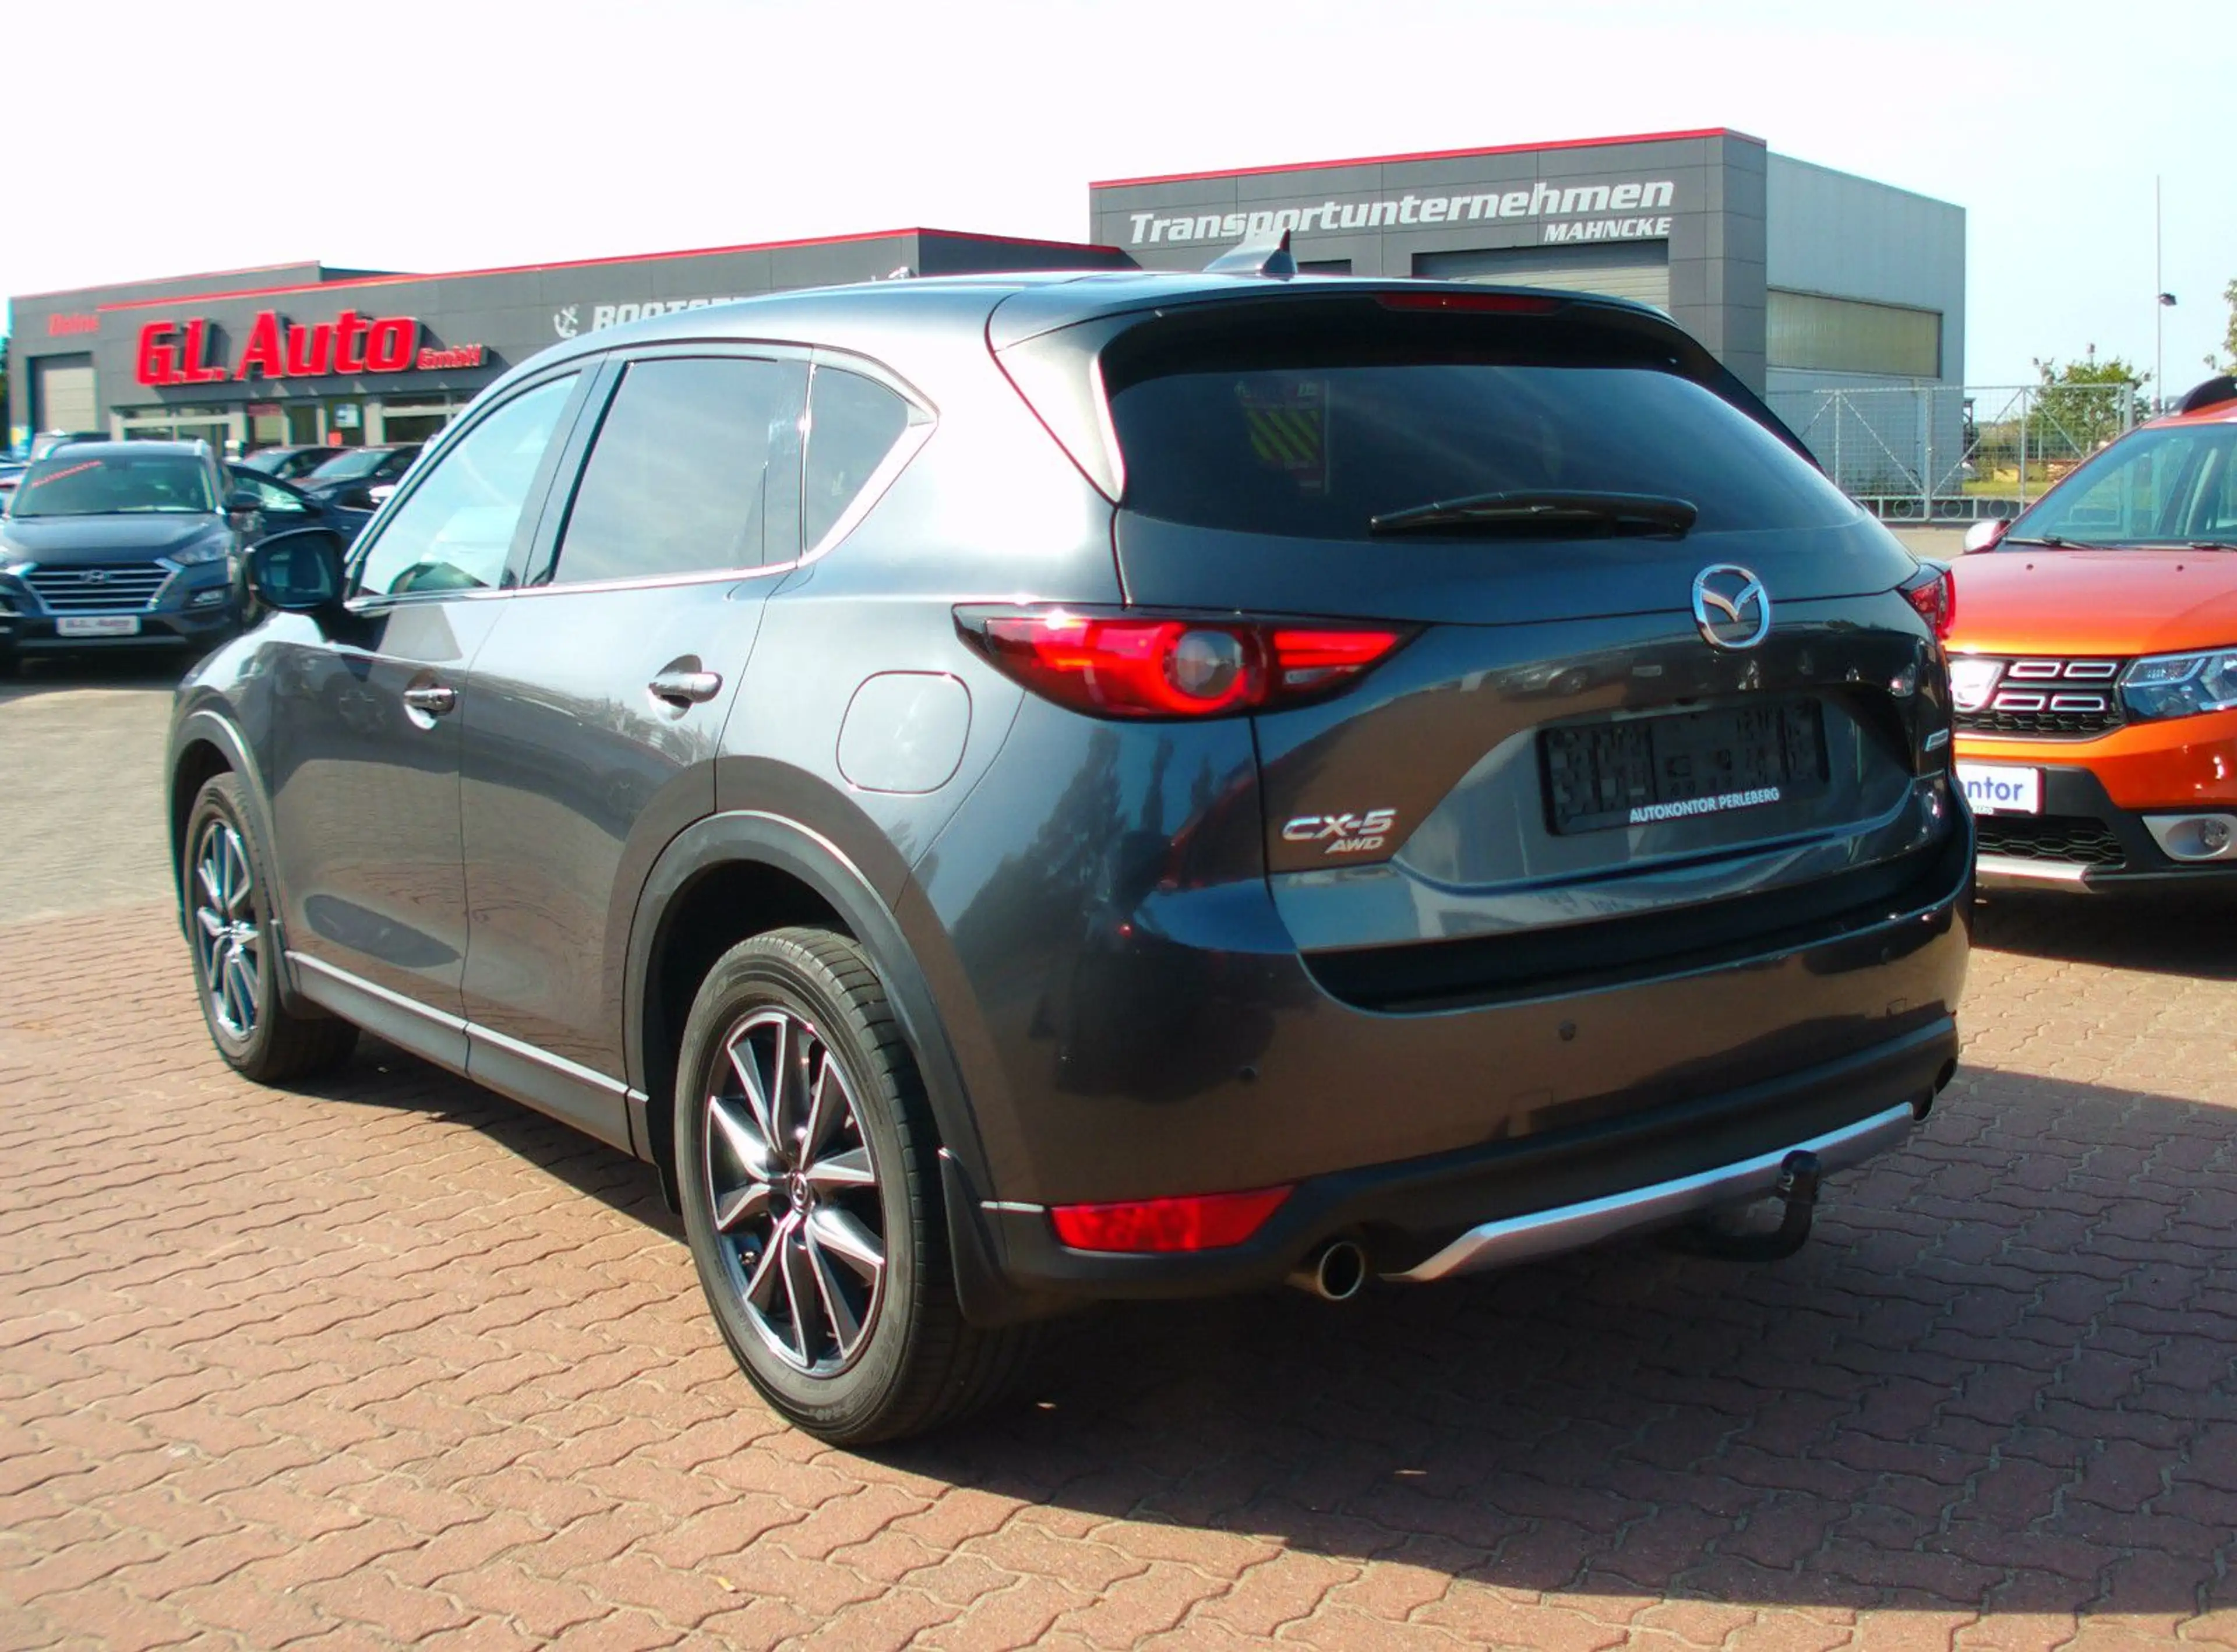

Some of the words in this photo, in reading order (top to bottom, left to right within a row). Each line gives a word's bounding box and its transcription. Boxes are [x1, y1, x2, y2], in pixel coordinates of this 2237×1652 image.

[1129, 180, 1674, 243] Transportunternehmen
[1543, 217, 1673, 242] MAHNCKE
[135, 317, 226, 386] G.L.
[234, 309, 418, 380] Auto
[417, 343, 482, 370] GmbH
[1629, 796, 1719, 823] AUTOKONTOR
[1719, 786, 1780, 810] PERLEBERG
[1964, 776, 2024, 801] ntor
[1282, 809, 1397, 841] CX-5
[1324, 835, 1385, 855] AWD
